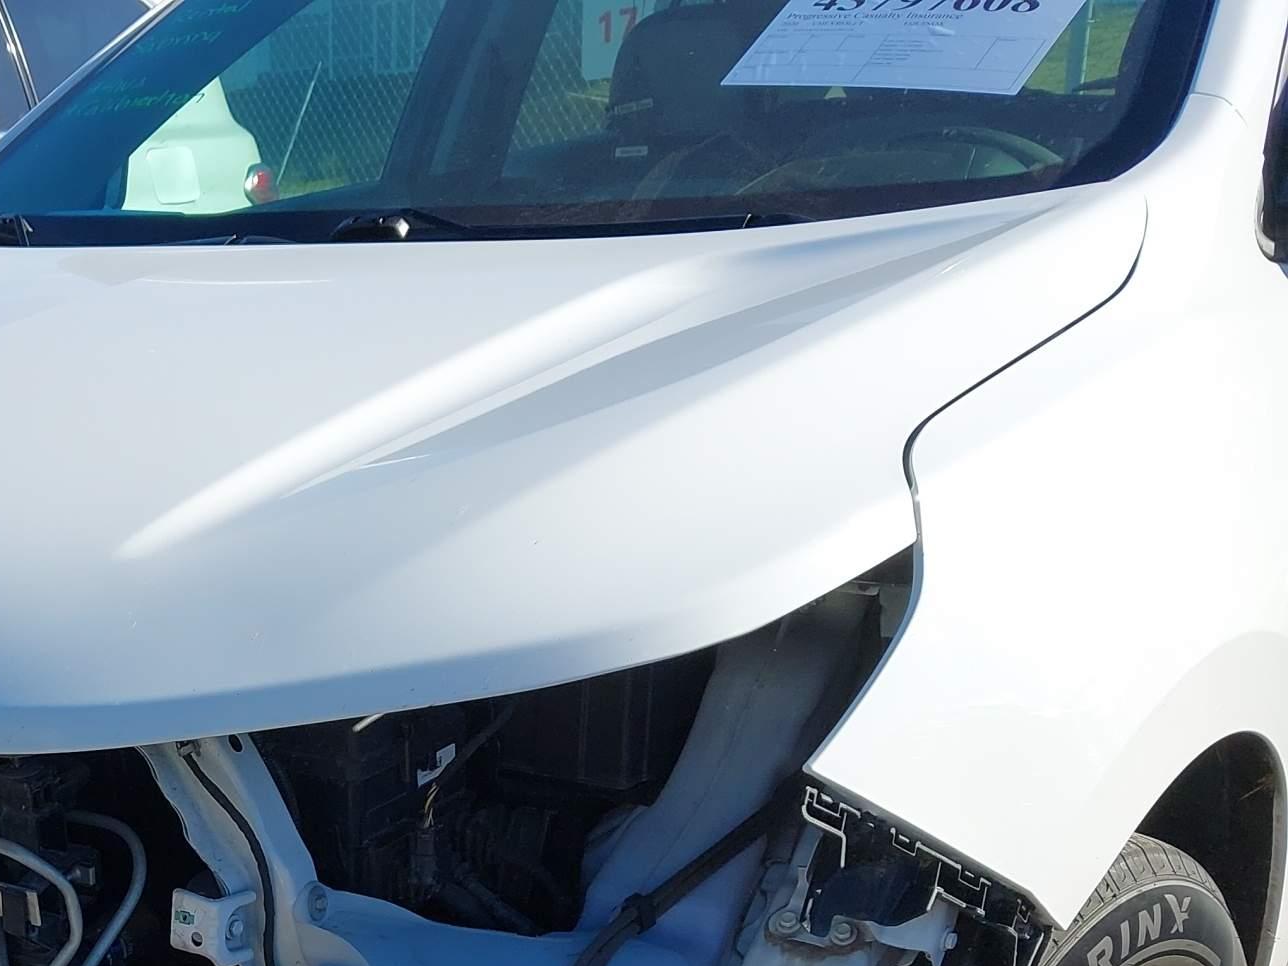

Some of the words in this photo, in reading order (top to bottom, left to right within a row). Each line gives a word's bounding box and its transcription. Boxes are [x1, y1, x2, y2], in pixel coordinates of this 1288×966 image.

[787, 12, 853, 20] Progressive
[854, 12, 901, 20] Casualty
[905, 12, 964, 20] Insurance
